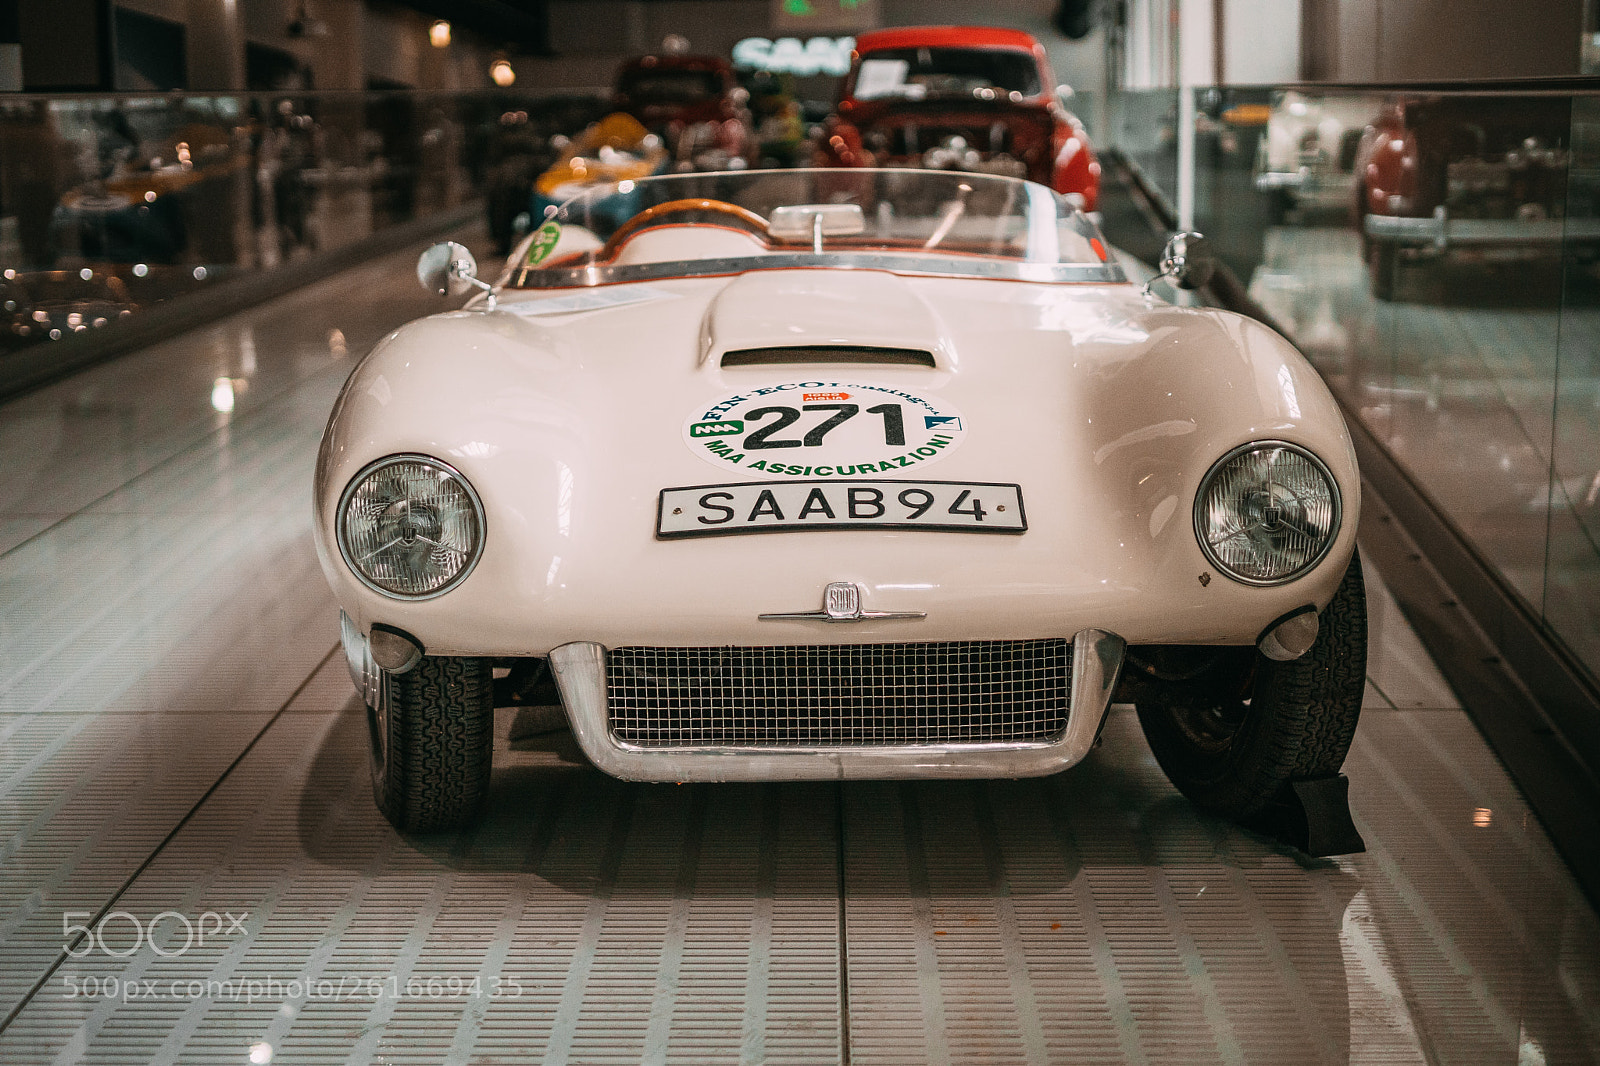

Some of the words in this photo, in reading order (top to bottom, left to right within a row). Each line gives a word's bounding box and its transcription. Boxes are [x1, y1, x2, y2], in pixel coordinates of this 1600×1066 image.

[702, 382, 825, 420] FIN-ECO
[743, 404, 906, 450] 271
[704, 440, 746, 464] MAA
[748, 435, 953, 477] ASSICURAZIONI
[698, 488, 988, 525] SAAB94
[830, 588, 855, 609] SAAB
